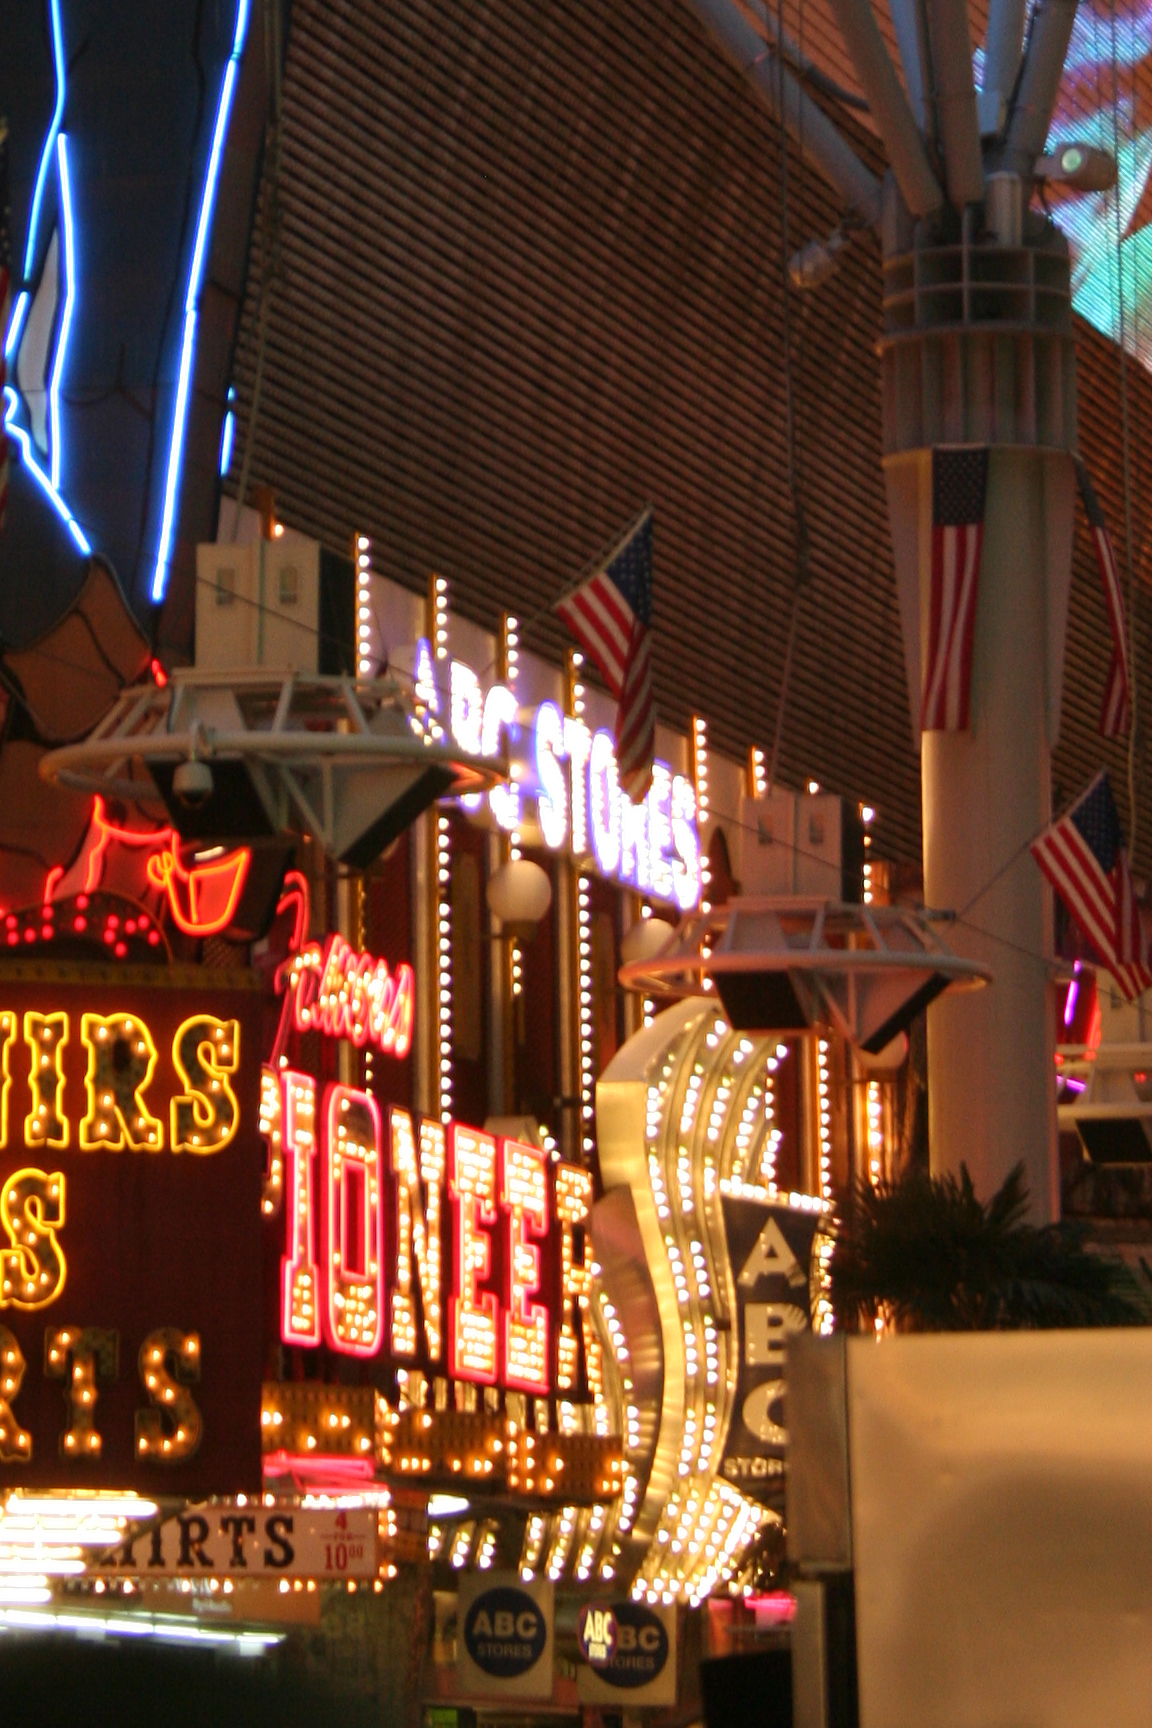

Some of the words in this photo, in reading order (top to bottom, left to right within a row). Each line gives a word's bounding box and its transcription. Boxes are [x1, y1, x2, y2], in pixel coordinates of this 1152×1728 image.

[722, 1456, 789, 1478] STOR
[472, 1609, 538, 1639] ABC
[582, 1609, 614, 1646] ABC
[616, 1624, 661, 1651] BC
[476, 1642, 533, 1658] STORES
[608, 1655, 656, 1670] TORES
